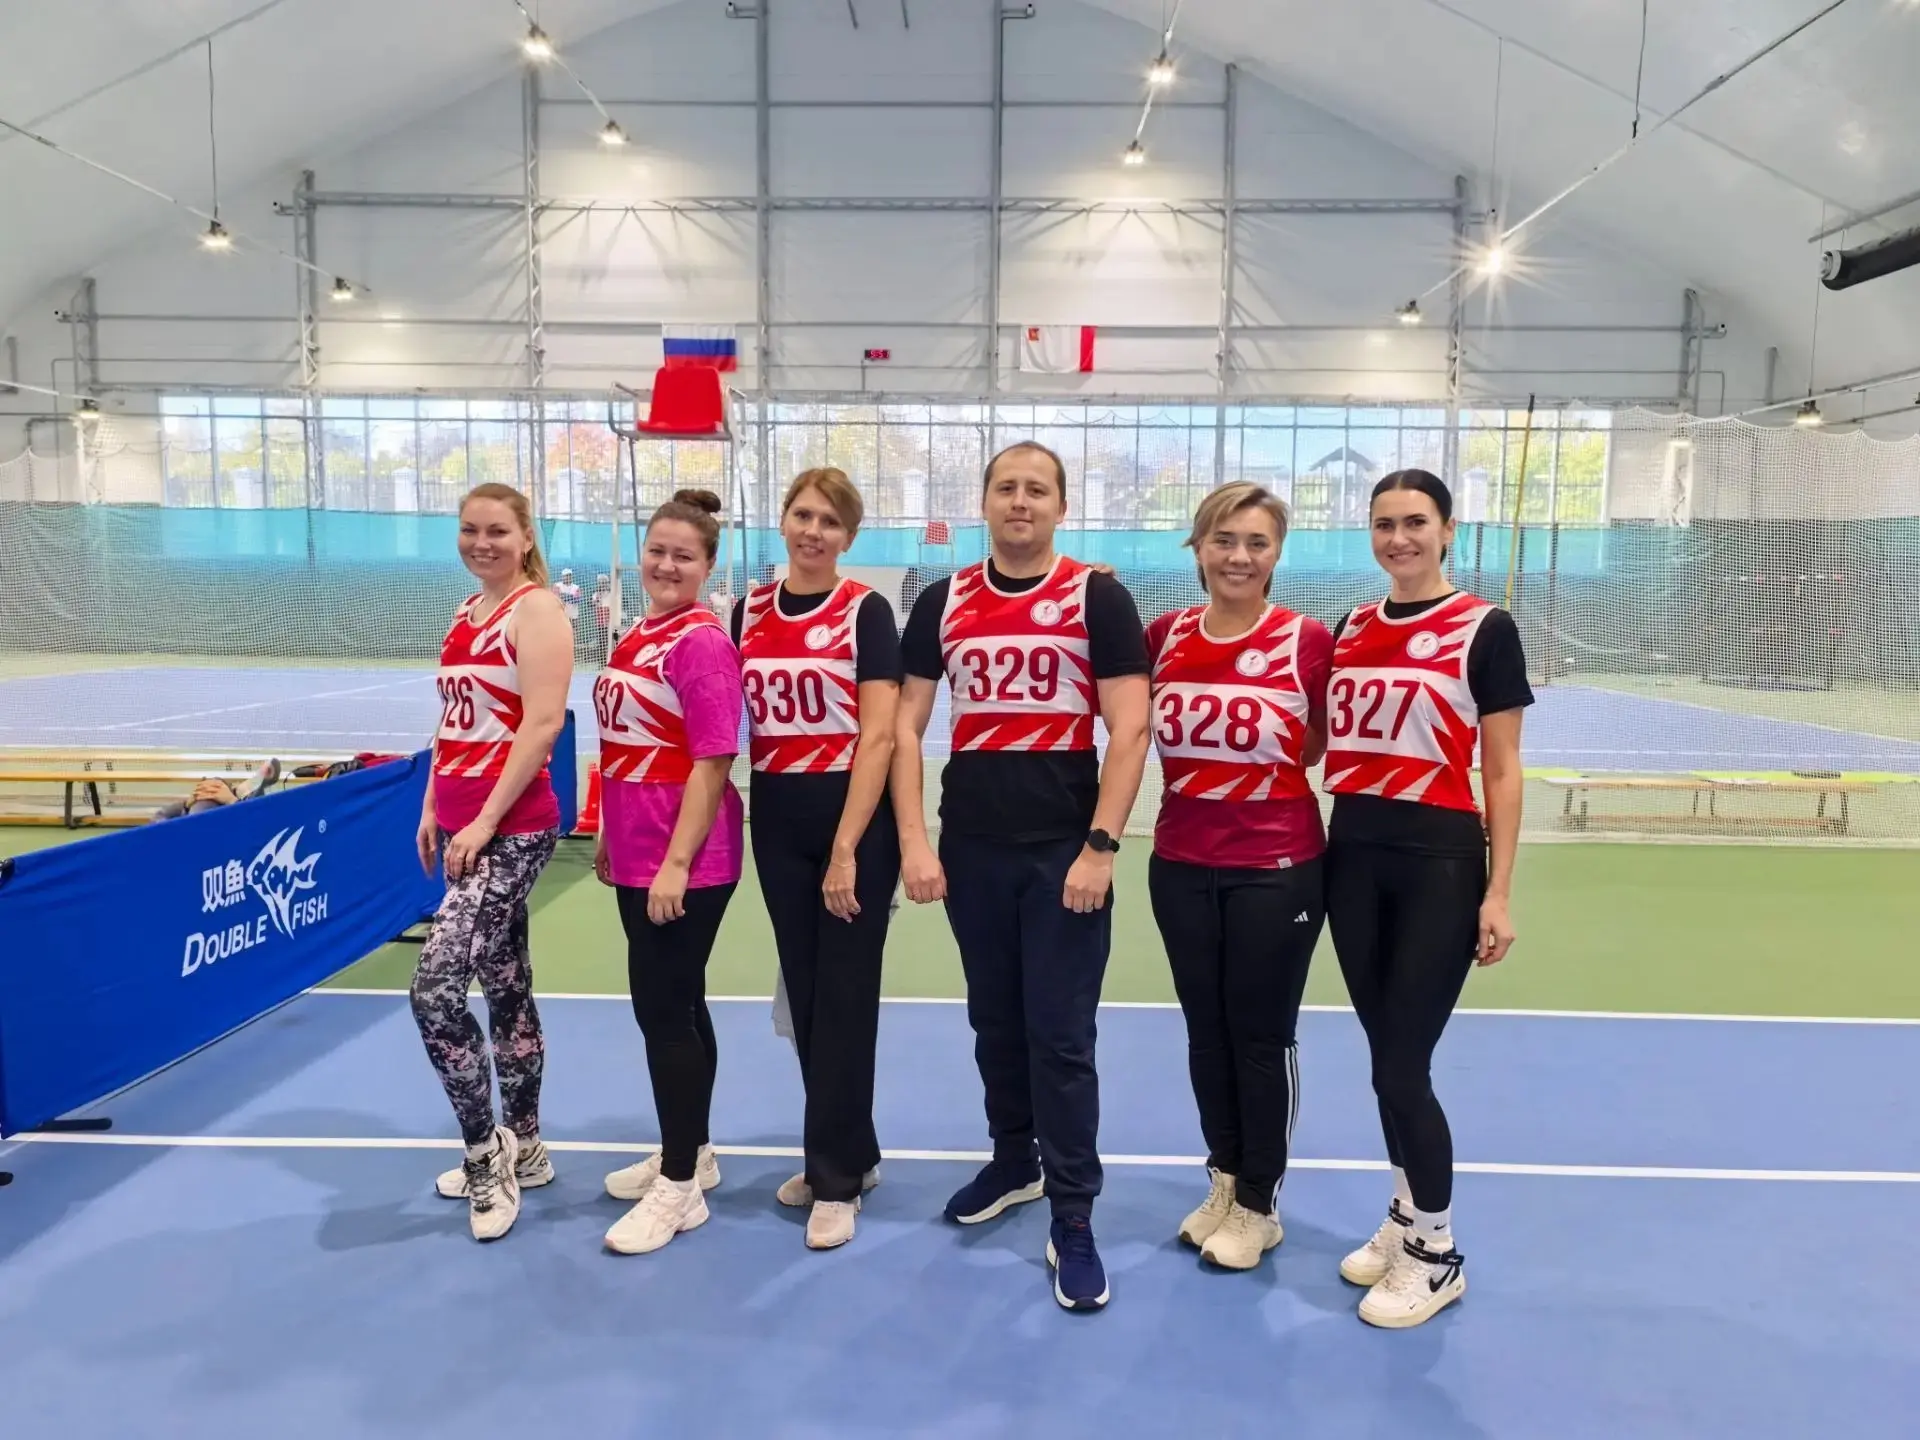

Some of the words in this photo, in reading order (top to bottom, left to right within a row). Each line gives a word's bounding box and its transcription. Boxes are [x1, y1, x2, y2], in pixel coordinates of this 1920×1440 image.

[743, 669, 827, 725] 330
[961, 646, 1060, 702] 329
[592, 675, 629, 733] 32
[1157, 693, 1262, 753] 328
[1330, 678, 1421, 741] 327
[181, 914, 268, 978] DOUBLE
[292, 892, 328, 930] FISH
